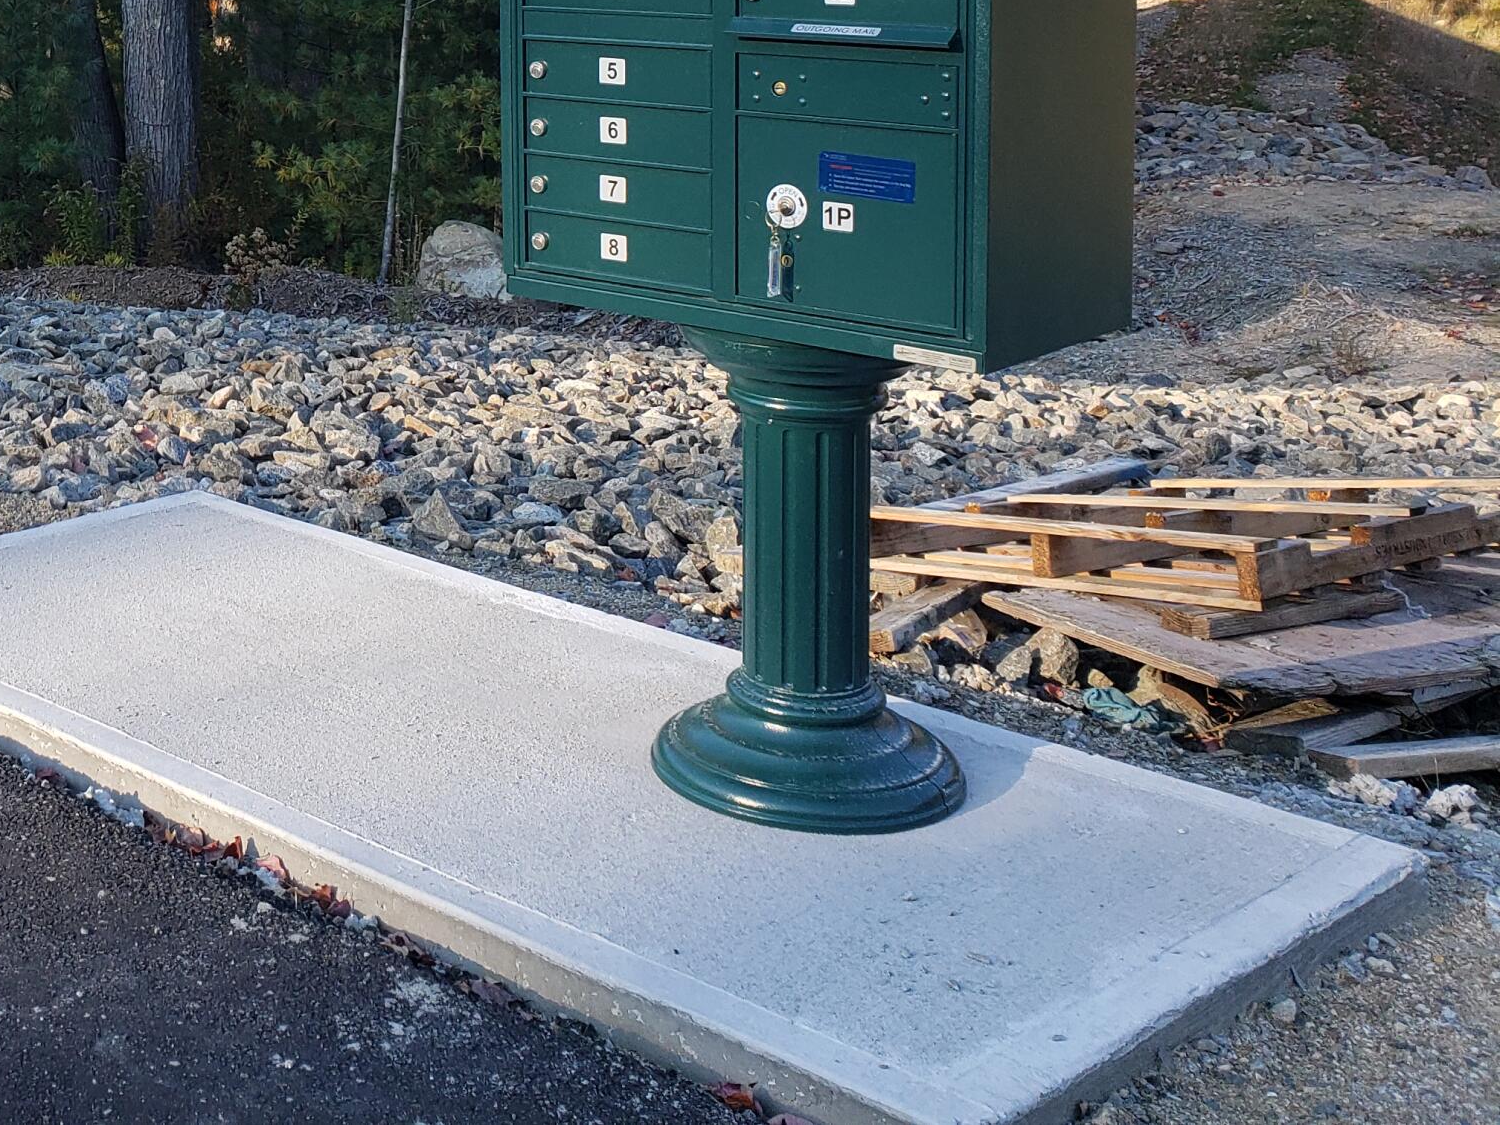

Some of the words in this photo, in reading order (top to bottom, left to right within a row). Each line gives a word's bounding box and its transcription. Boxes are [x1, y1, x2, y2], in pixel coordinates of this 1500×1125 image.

[796, 24, 849, 33] OUTGOING
[607, 62, 618, 80] 5
[608, 121, 618, 139] 6
[608, 179, 618, 197] 7
[778, 187, 798, 198] OPEN
[824, 206, 852, 226] 1P
[609, 238, 619, 256] 8
